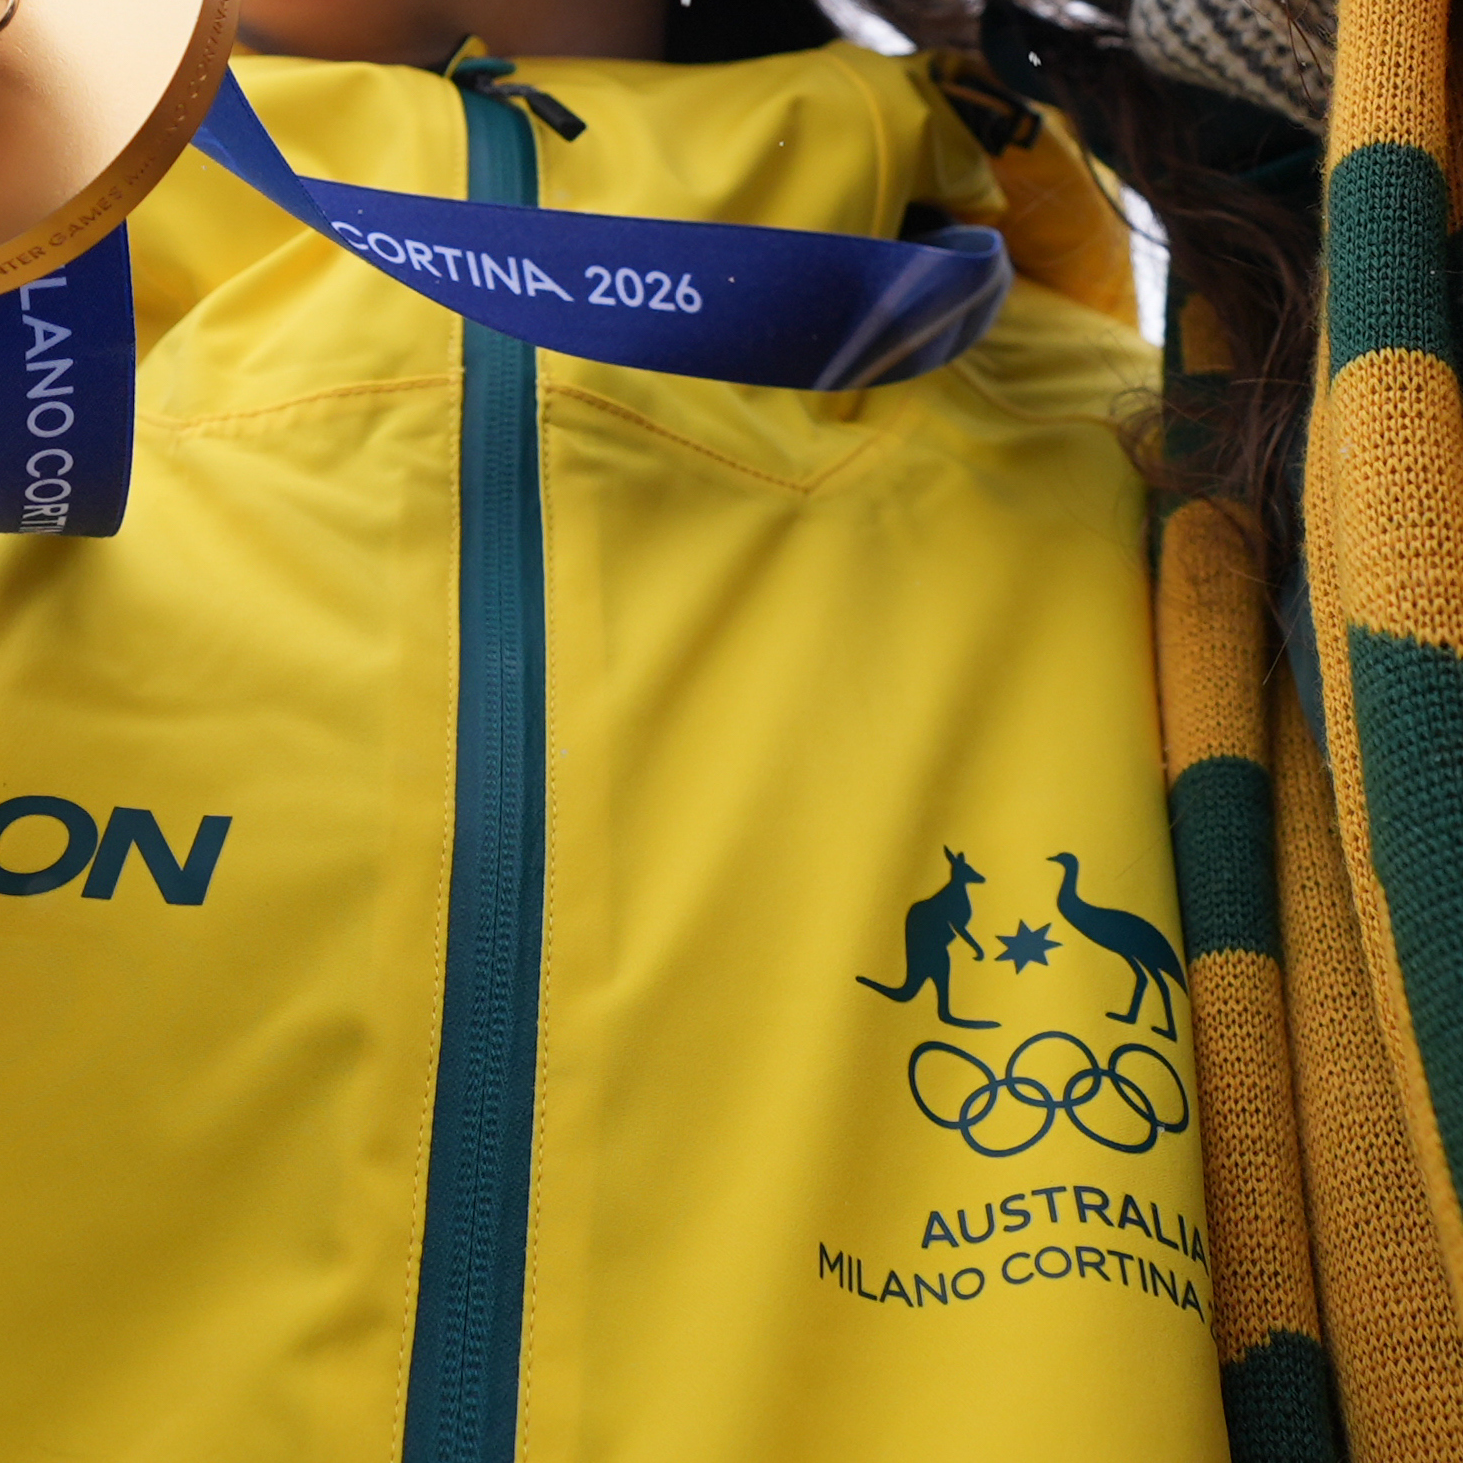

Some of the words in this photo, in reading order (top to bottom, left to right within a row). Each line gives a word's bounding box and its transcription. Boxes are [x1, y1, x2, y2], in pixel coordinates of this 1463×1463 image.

[48, 185, 124, 247] GAMES
[330, 220, 575, 303] CORTINA
[584, 264, 704, 314] 2026
[19, 264, 75, 439] LANO
[19, 447, 75, 533] CORTI
[920, 1185, 1210, 1278] AUSTRALIA
[818, 1240, 986, 1308] MILANO
[1001, 1245, 1206, 1325] CORTINA
